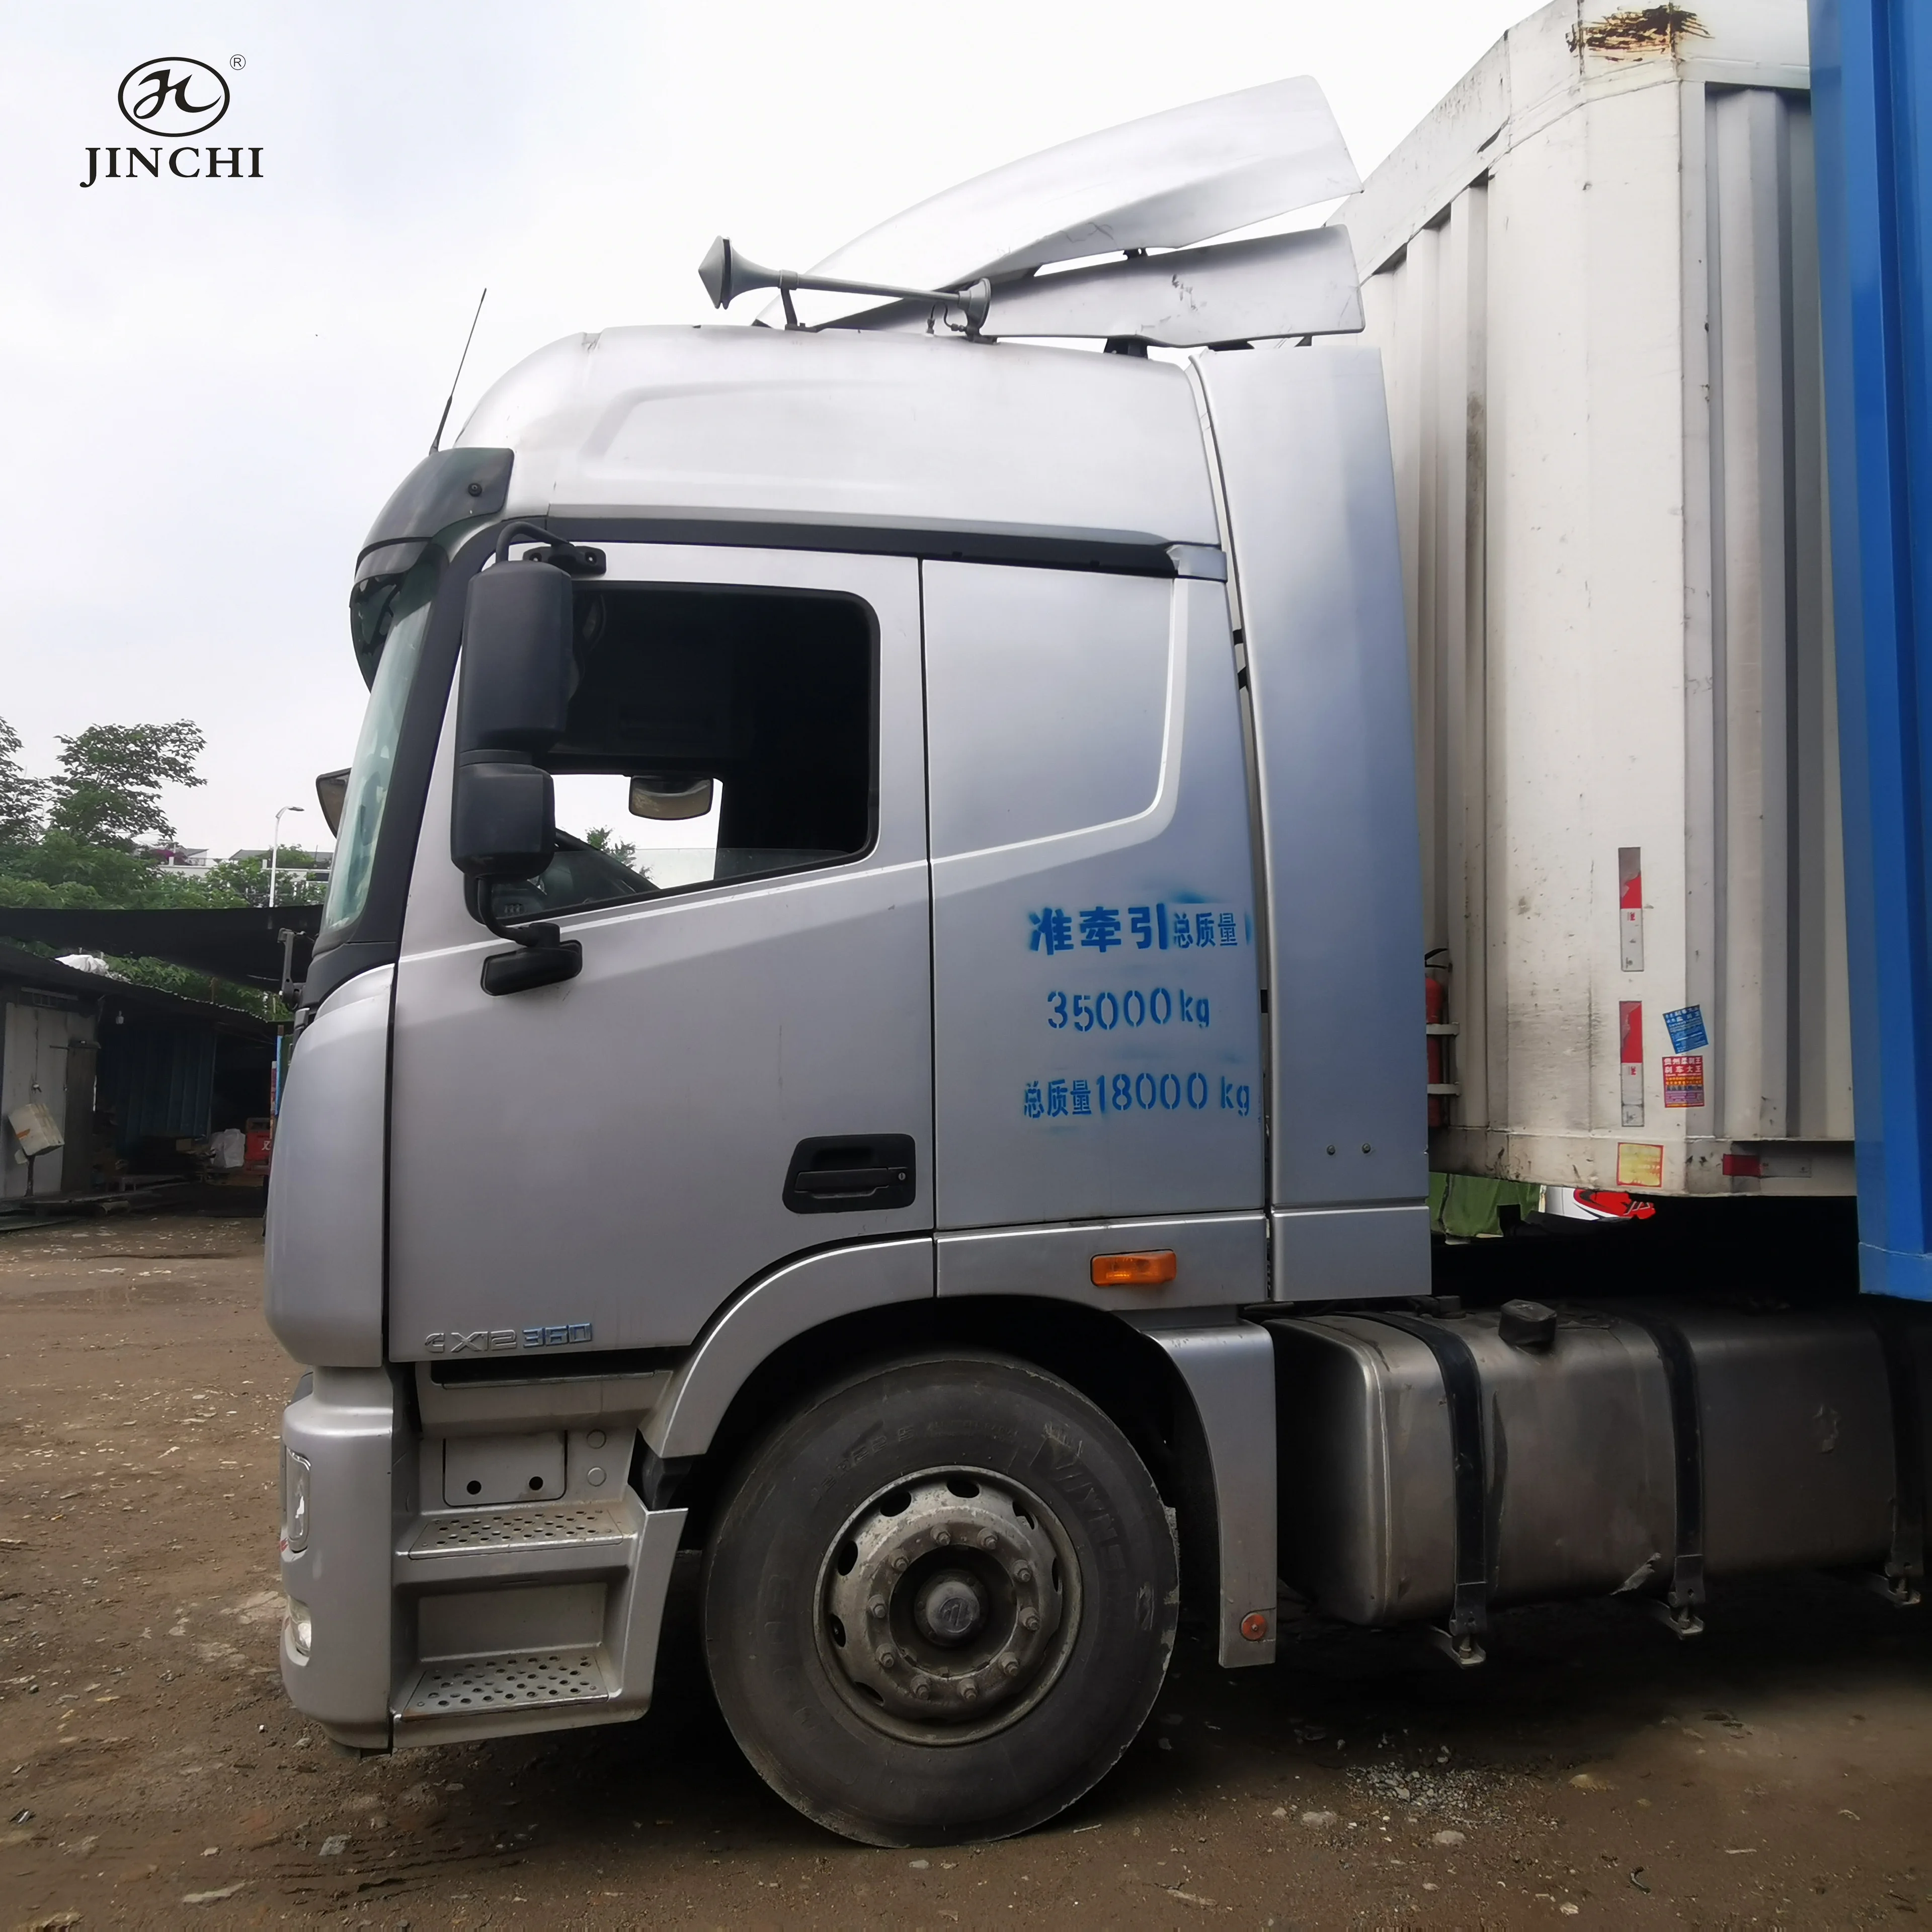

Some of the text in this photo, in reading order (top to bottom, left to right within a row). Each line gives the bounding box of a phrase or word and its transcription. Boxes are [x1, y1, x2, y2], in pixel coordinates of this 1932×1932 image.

[1047, 987, 1211, 1032] 35000 kg
[1220, 1075, 1251, 1116] kg
[522, 1322, 593, 1349] 360
